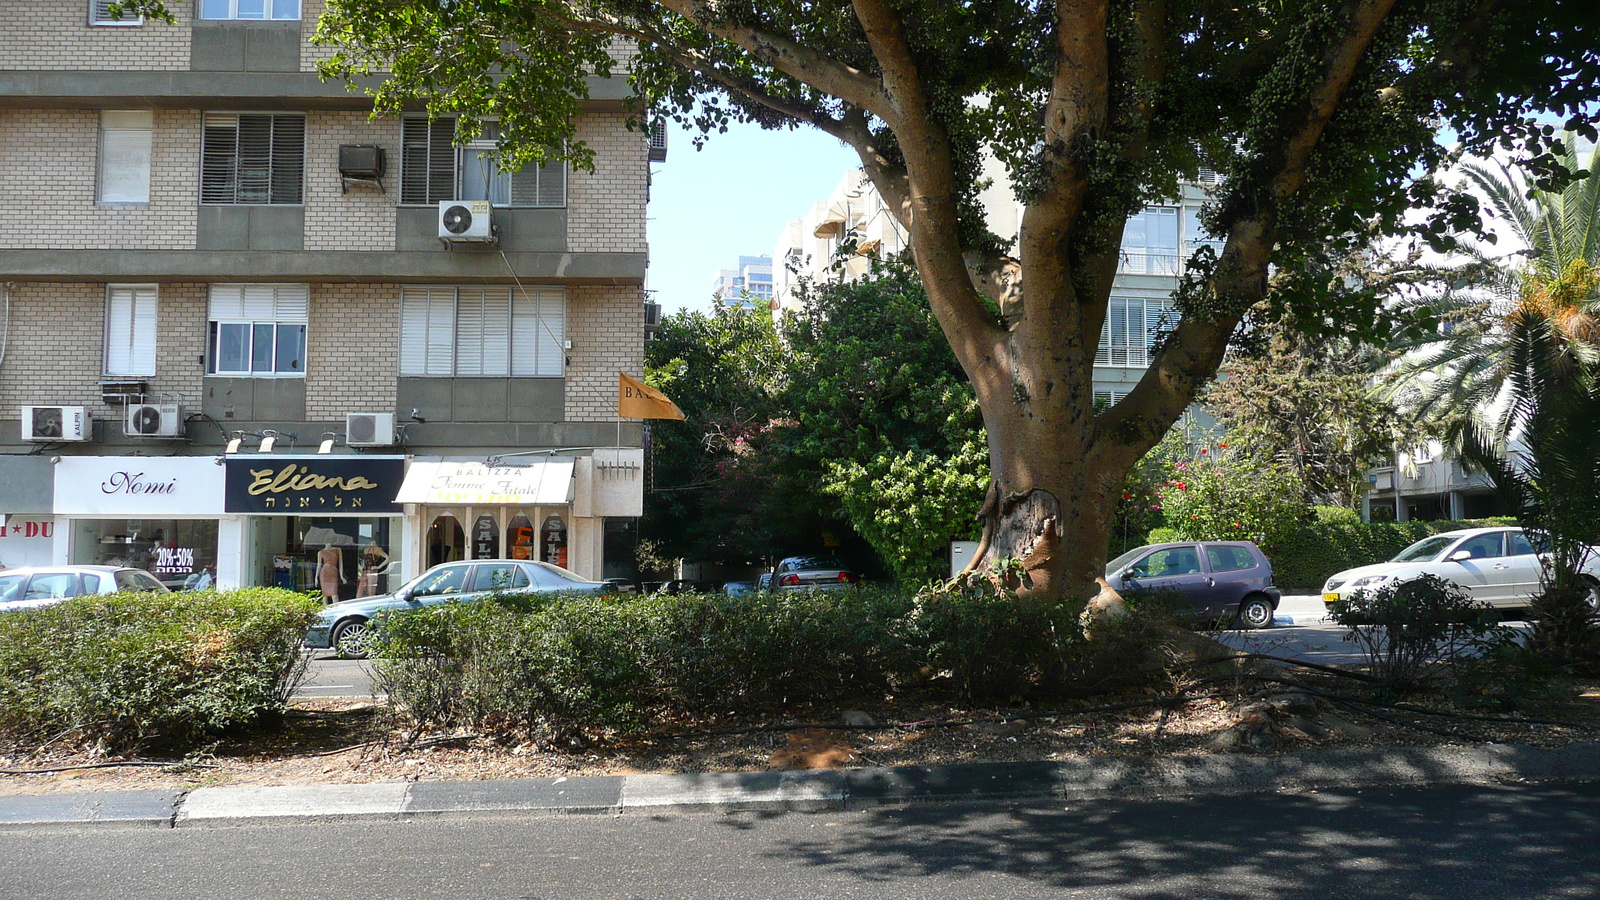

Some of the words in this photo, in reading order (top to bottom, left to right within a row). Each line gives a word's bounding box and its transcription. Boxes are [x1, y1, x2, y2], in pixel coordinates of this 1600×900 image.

[248, 463, 378, 496] Eliana
[456, 468, 522, 476] BALIZZA
[101, 471, 177, 495] Nomi
[432, 475, 485, 489] Femme
[491, 480, 537, 494] Fatale
[265, 496, 362, 508] אליאנה
[547, 520, 561, 565] SALE
[156, 547, 194, 567] 20%-50%
